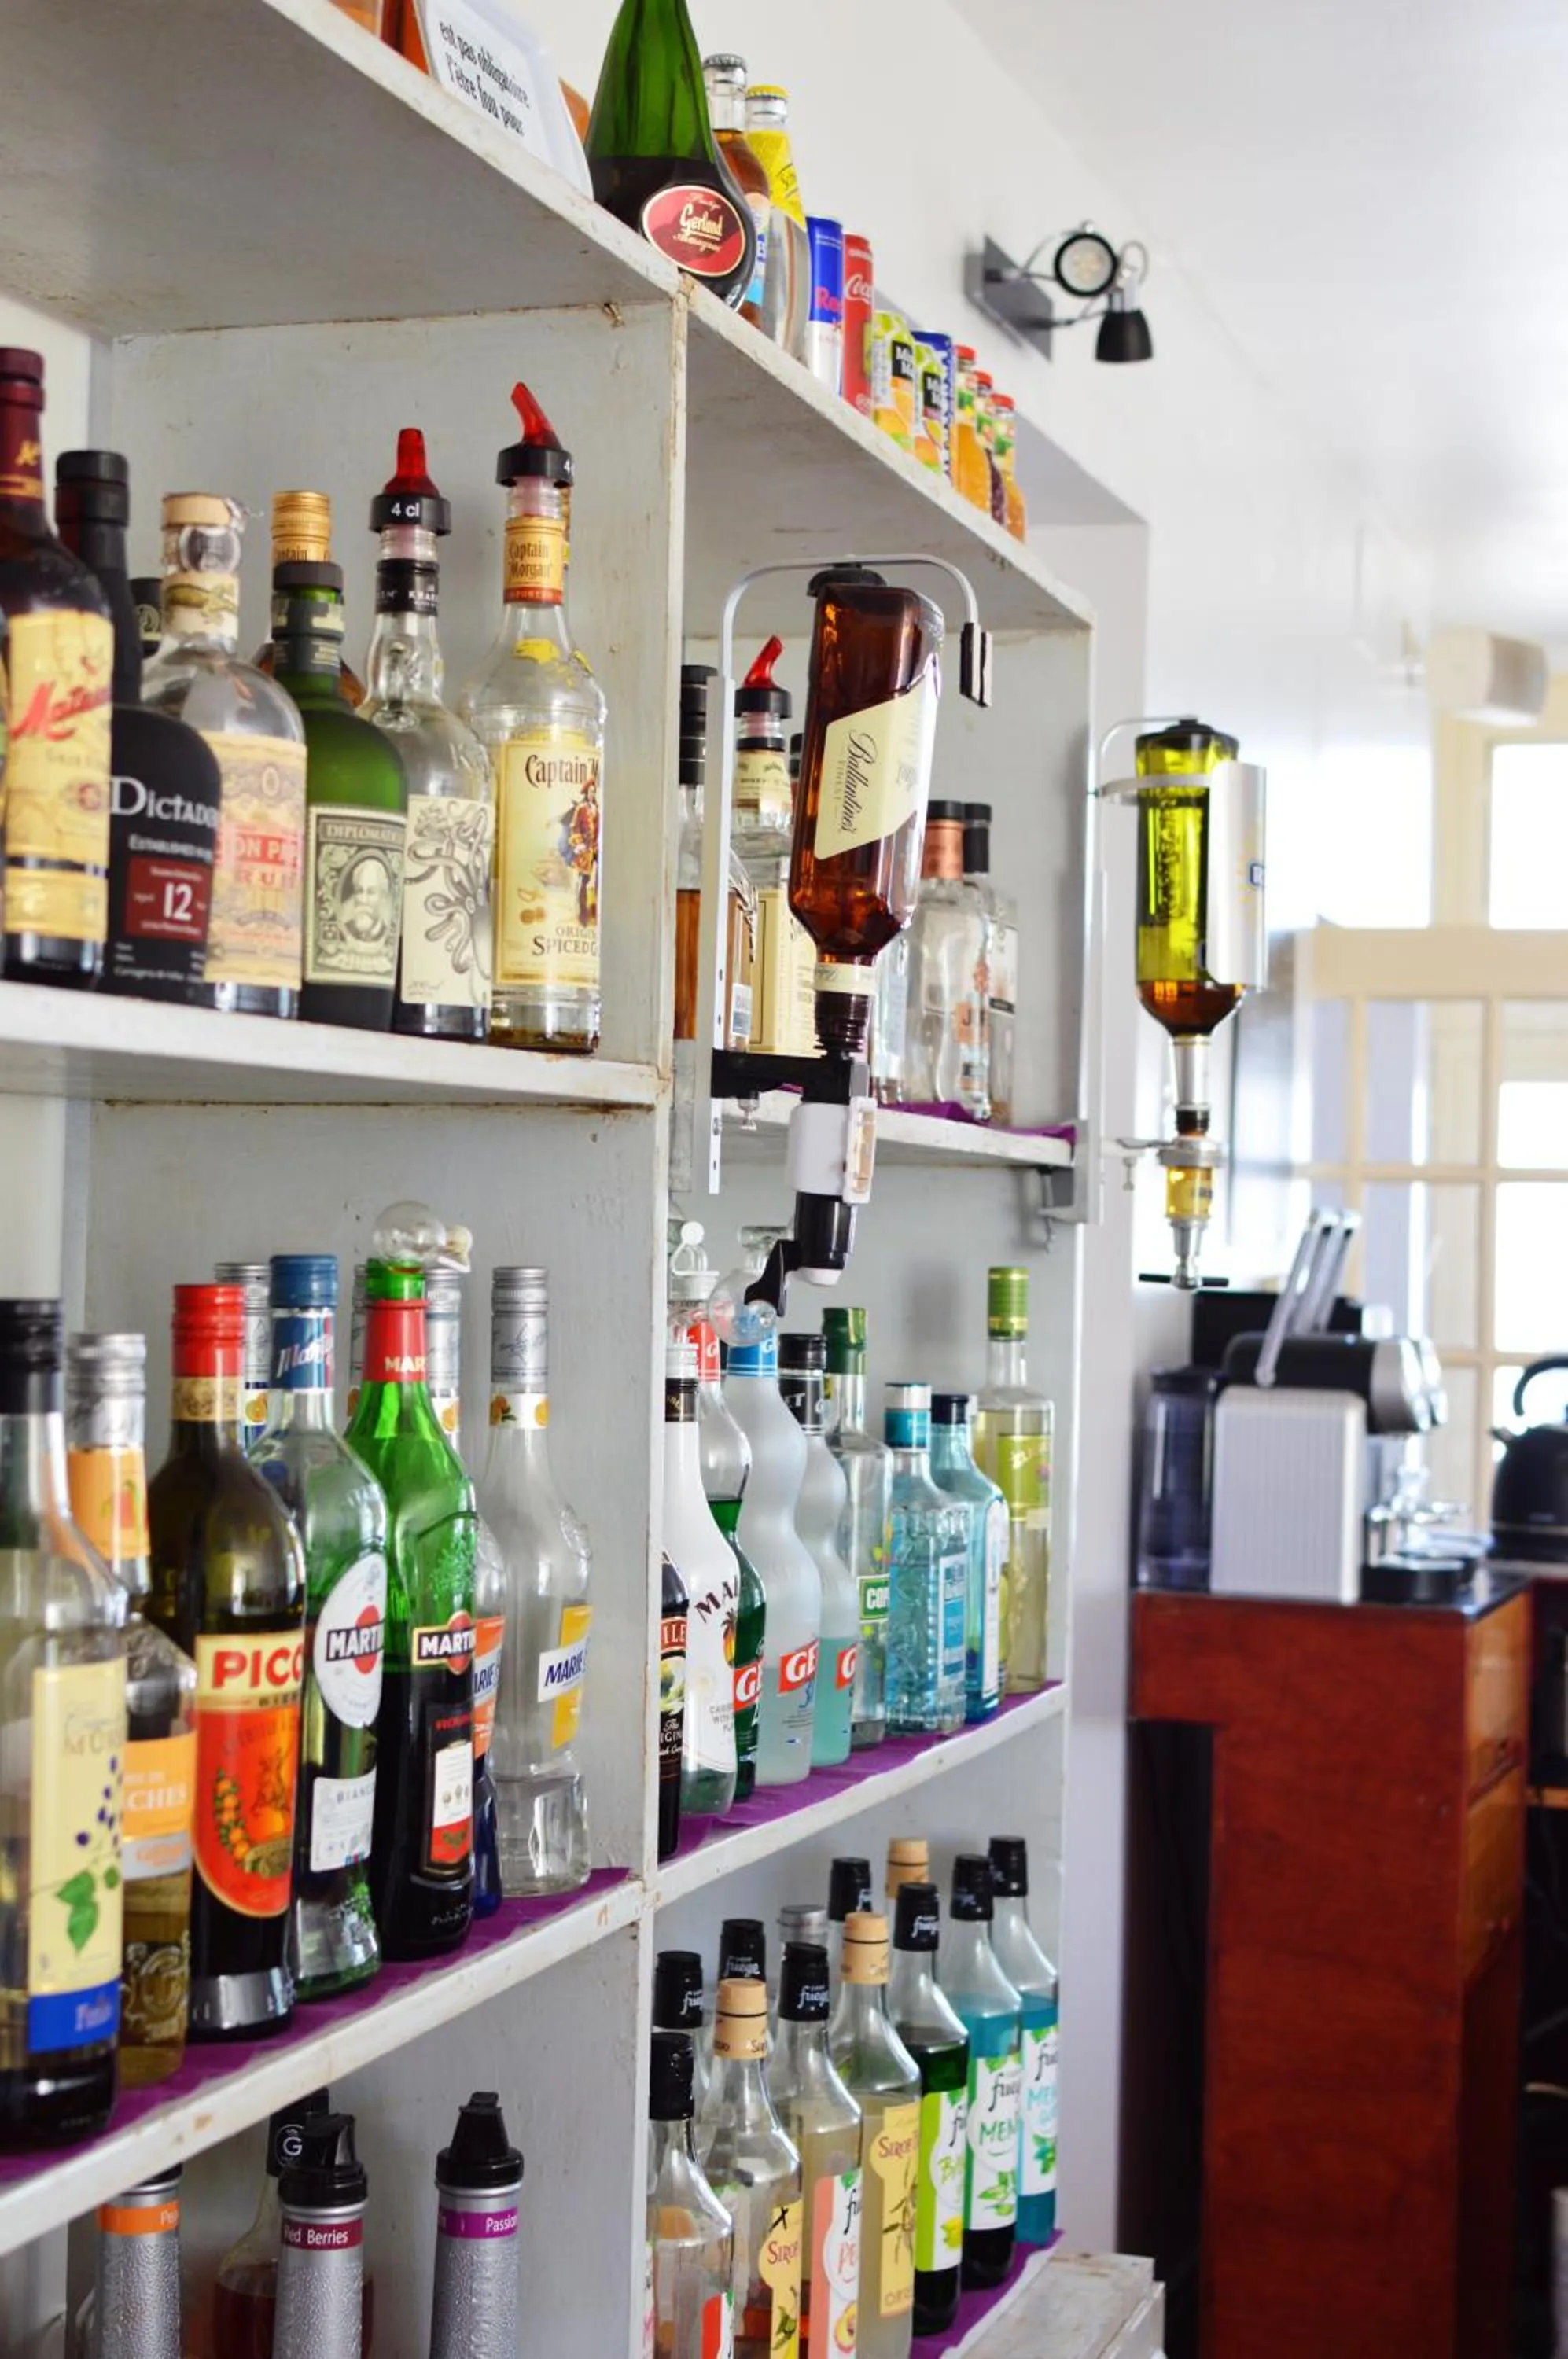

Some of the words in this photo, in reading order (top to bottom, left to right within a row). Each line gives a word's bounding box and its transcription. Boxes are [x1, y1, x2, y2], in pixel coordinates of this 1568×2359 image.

[391, 502, 402, 517] 4
[405, 502, 420, 517] cl
[525, 754, 587, 788] Captain
[163, 881, 193, 922] 12
[385, 1356, 426, 1373] MAR
[282, 2136, 304, 2156] G
[307, 2228, 348, 2246] Berries
